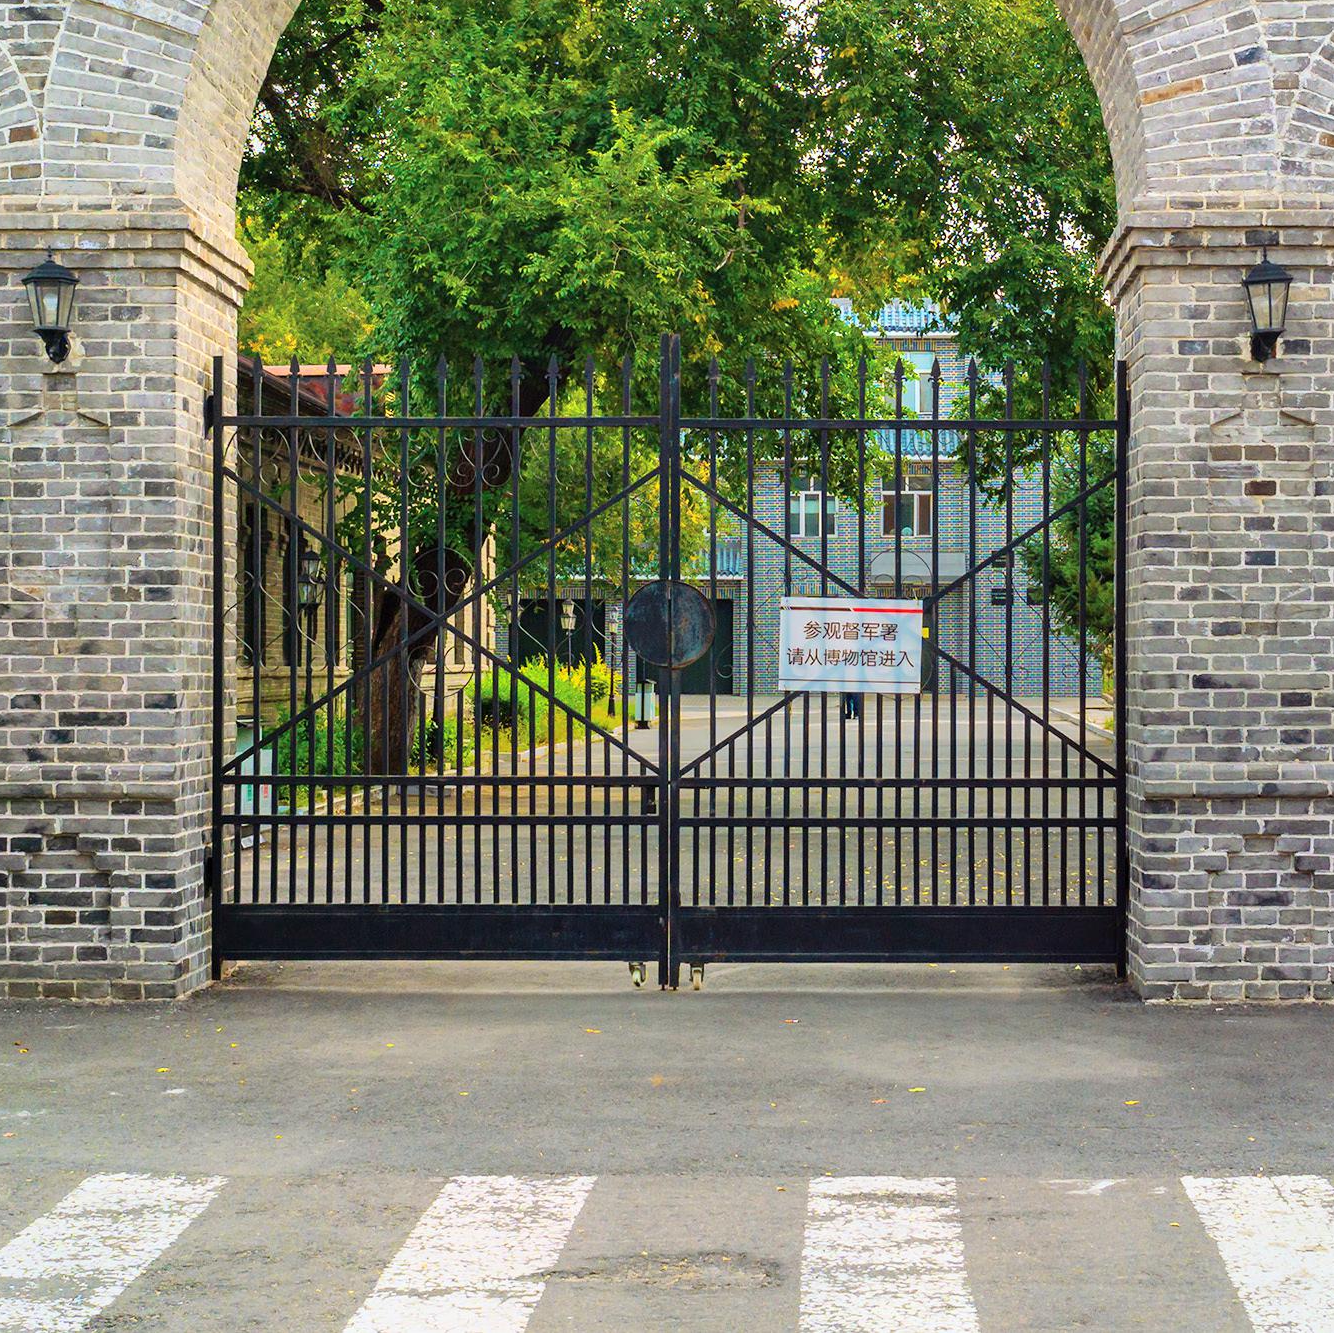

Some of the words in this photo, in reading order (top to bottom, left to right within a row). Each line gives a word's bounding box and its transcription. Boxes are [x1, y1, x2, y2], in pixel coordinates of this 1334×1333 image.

[803, 620, 899, 642] 参观督军署
[786, 647, 915, 668] 请从博物馆进入
